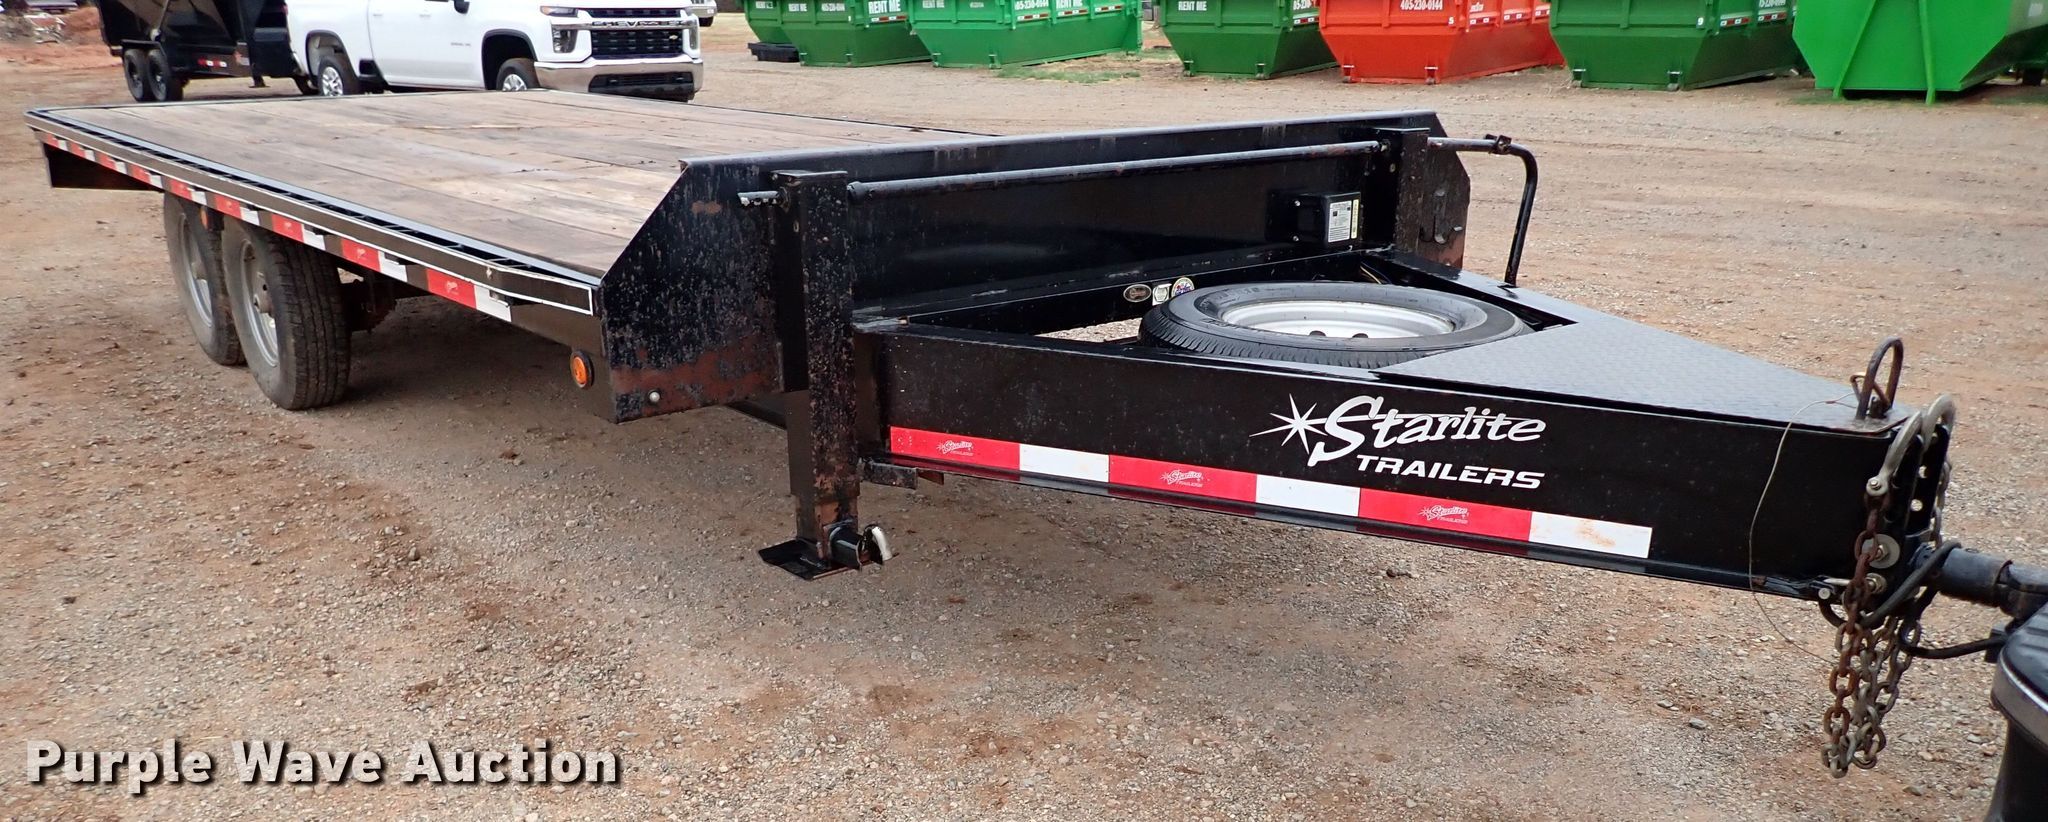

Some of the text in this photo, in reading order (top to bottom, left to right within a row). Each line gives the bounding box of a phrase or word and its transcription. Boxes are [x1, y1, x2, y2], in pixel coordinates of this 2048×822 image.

[868, 0, 901, 14] RENT ME
[1178, 1, 1195, 11] RENT
[1307, 395, 1547, 467] Starlite
[1356, 454, 1546, 489] TRAILERS
